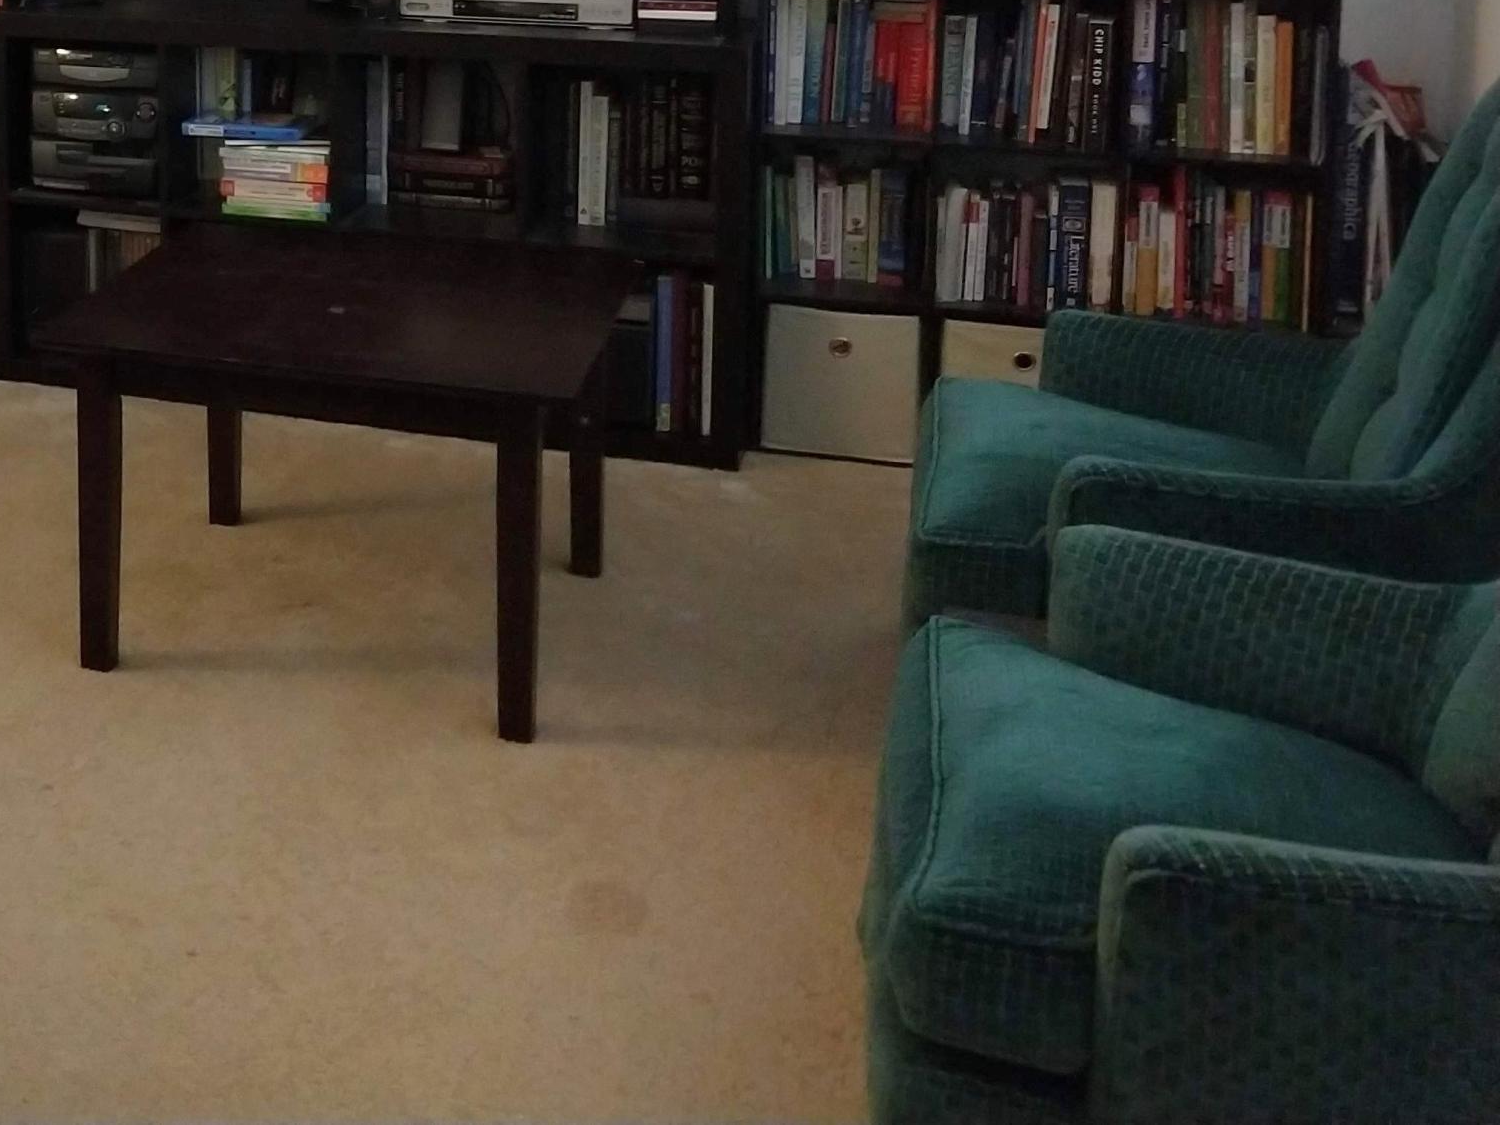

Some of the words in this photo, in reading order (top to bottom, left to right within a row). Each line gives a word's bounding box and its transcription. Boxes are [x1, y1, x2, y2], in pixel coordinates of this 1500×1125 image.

[1094, 28, 1104, 55] CHIP
[1092, 58, 1103, 86] KIDD
[1068, 235, 1085, 293] Literature
